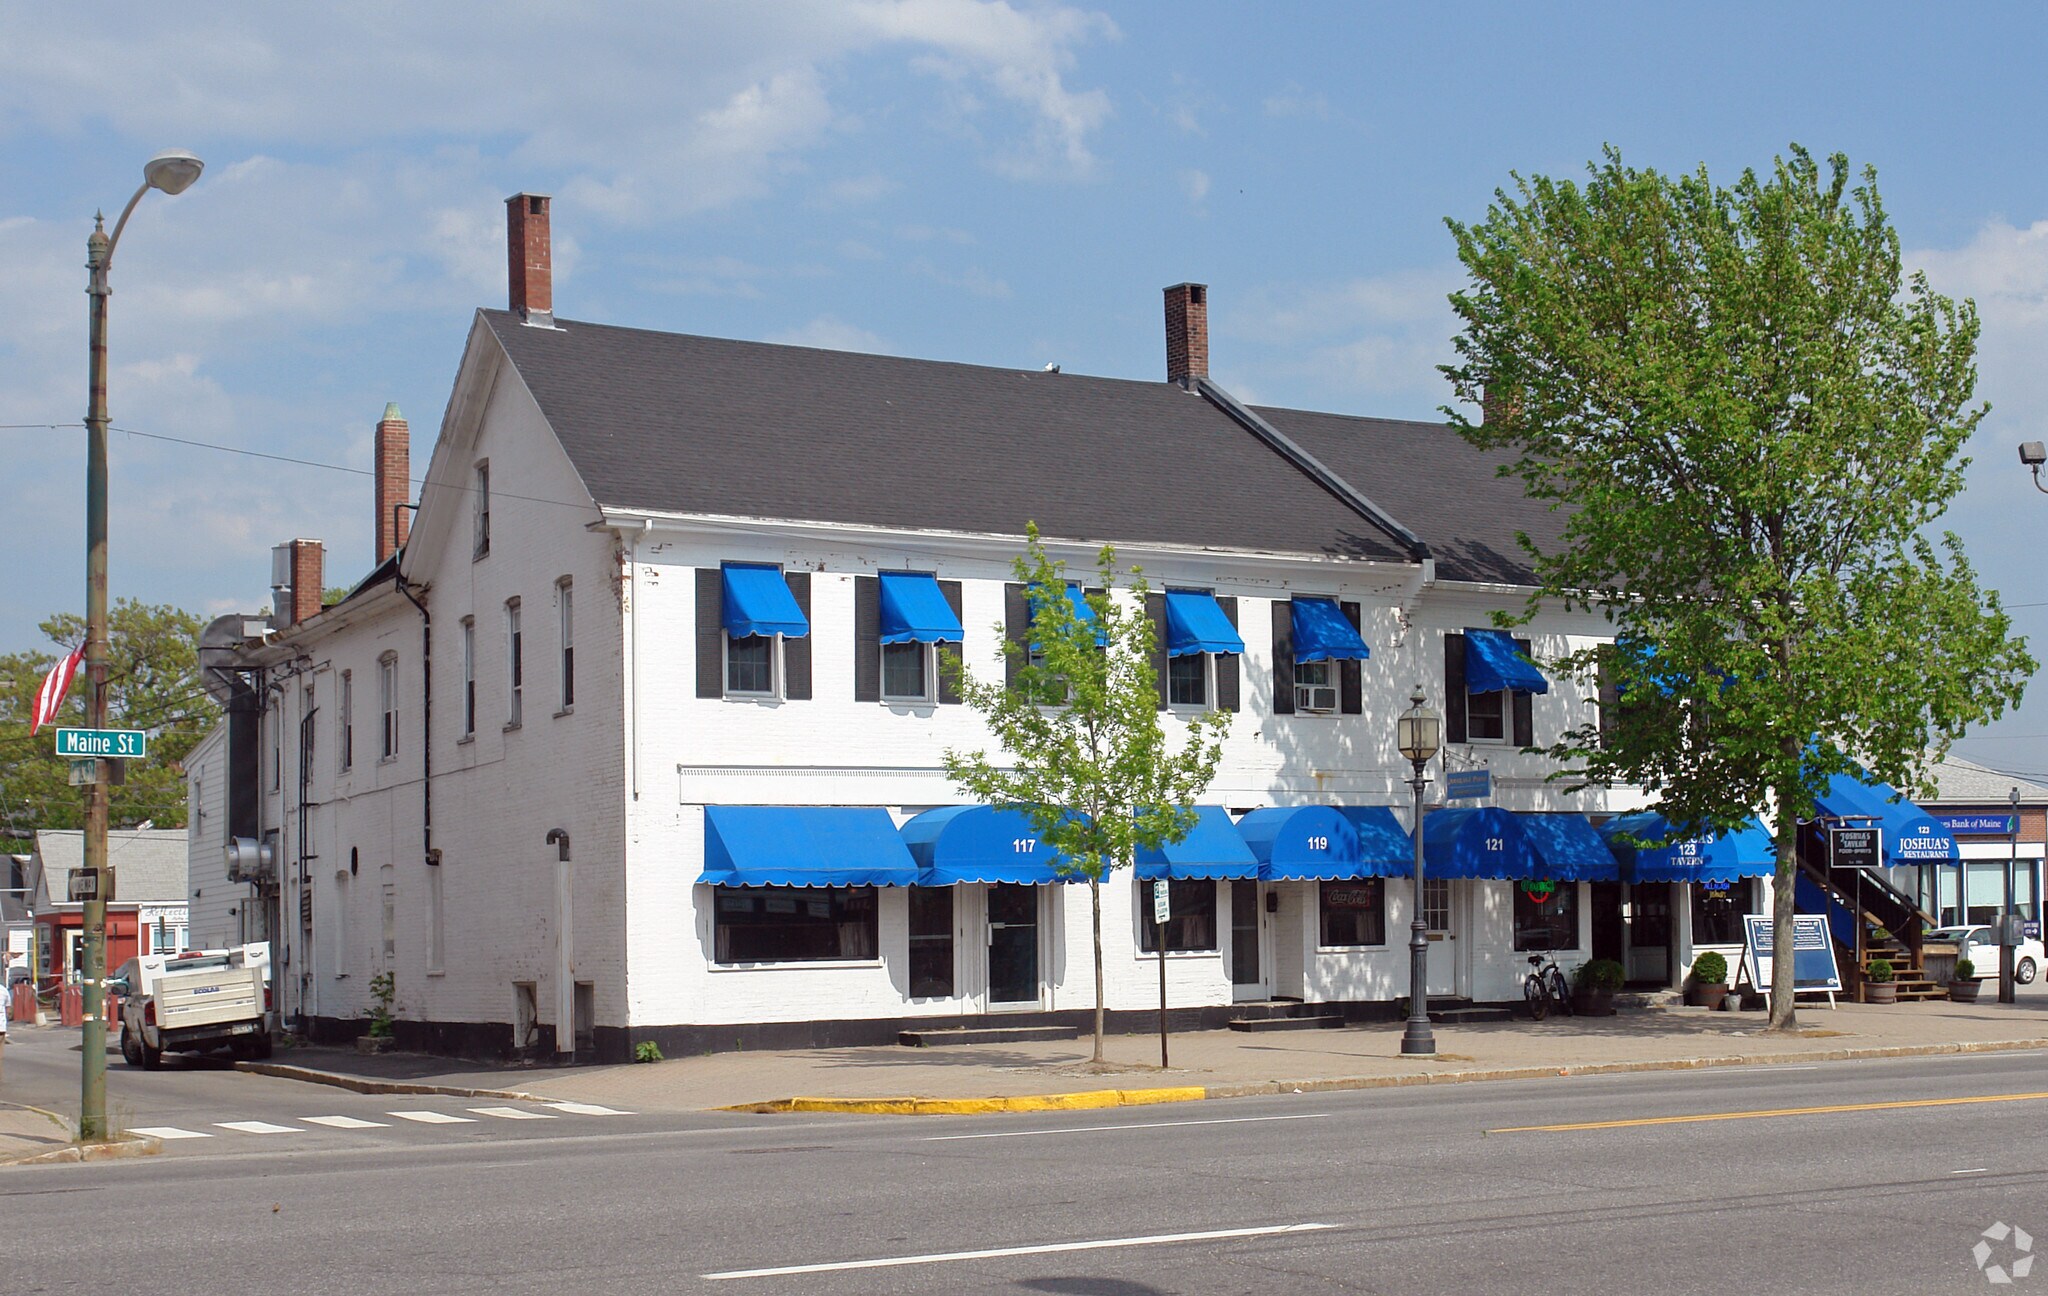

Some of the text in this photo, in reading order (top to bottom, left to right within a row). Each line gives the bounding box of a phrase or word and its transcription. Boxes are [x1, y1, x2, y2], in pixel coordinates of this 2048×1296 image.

[67, 732, 135, 754] Maine St
[1918, 826, 1930, 834] 123
[1952, 818, 1970, 828] Bank
[1971, 819, 1979, 829] of
[1979, 818, 2002, 828] Maine
[1013, 838, 1036, 853] 117
[1307, 836, 1328, 850] 119
[1485, 838, 1503, 851] 121
[1679, 843, 1697, 856] 123
[1898, 837, 1950, 853] JOSHUA'S
[1670, 856, 1704, 866] TAVERN
[1903, 850, 1949, 859] RESTAURANT
